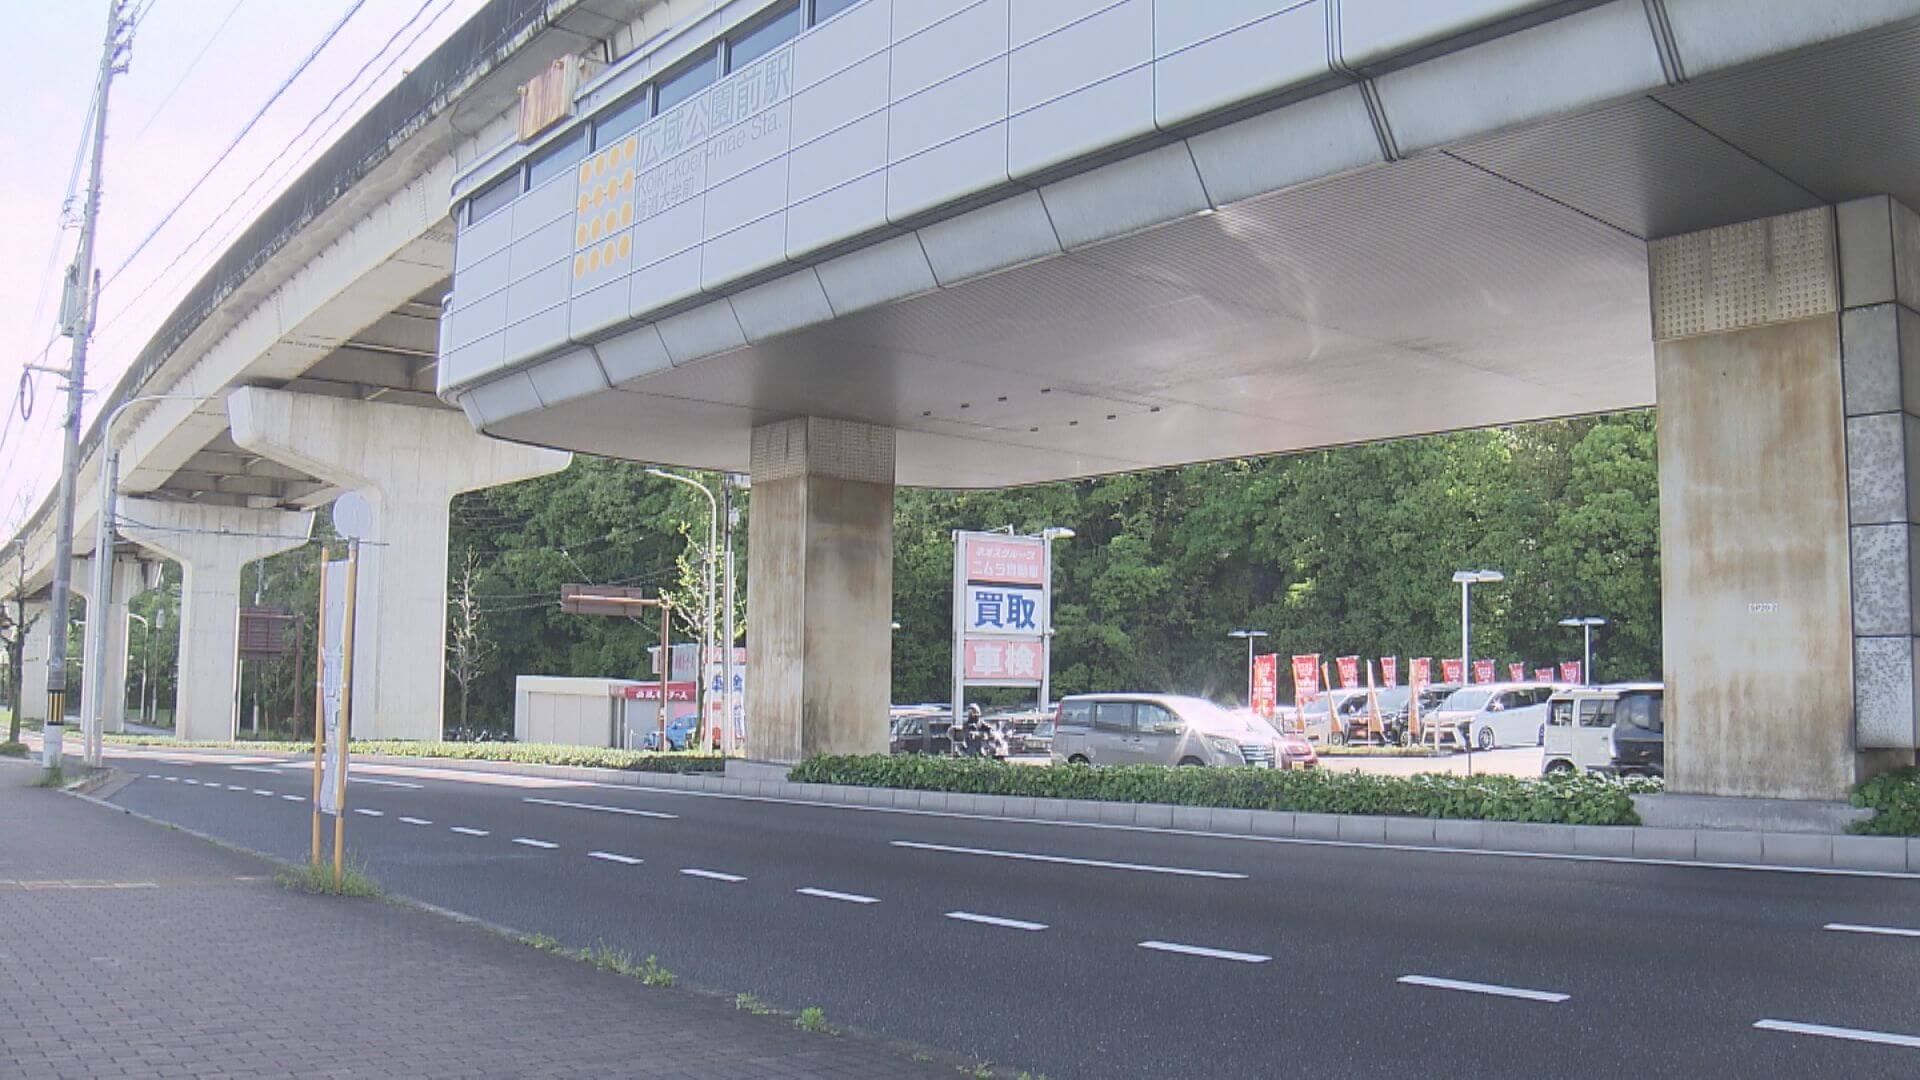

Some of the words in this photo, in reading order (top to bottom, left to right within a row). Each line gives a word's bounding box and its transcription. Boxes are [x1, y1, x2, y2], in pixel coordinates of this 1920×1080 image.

[641, 51, 790, 168] 広域公園前駅
[752, 112, 782, 141] Sta.
[975, 591, 1035, 629] 買取
[974, 644, 1035, 676] 車検
